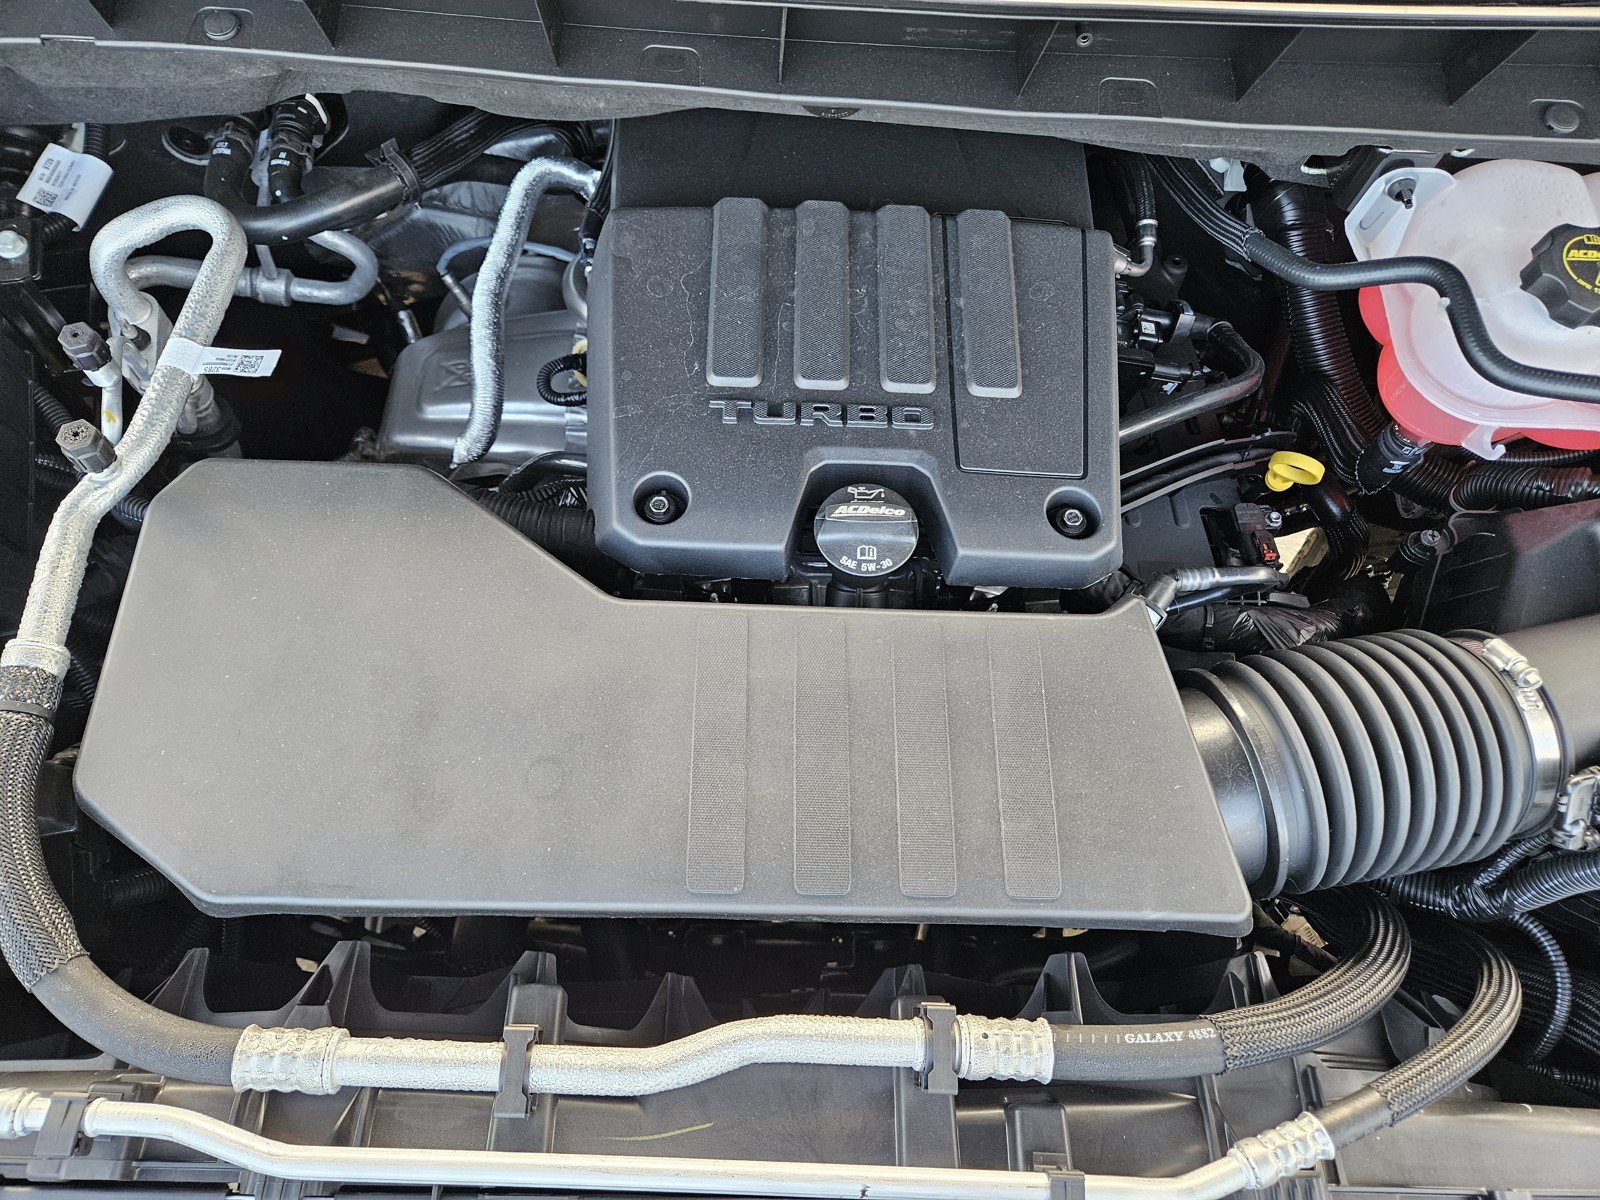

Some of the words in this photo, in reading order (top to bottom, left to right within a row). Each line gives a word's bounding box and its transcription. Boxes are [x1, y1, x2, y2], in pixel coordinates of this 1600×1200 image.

[709, 400, 934, 429] TURBO
[832, 505, 906, 517] ACDelco
[840, 556, 858, 569] SAE
[861, 558, 893, 572] 5W-30
[1124, 1030, 1184, 1043] GALAXY
[1188, 1027, 1217, 1040] 4882
